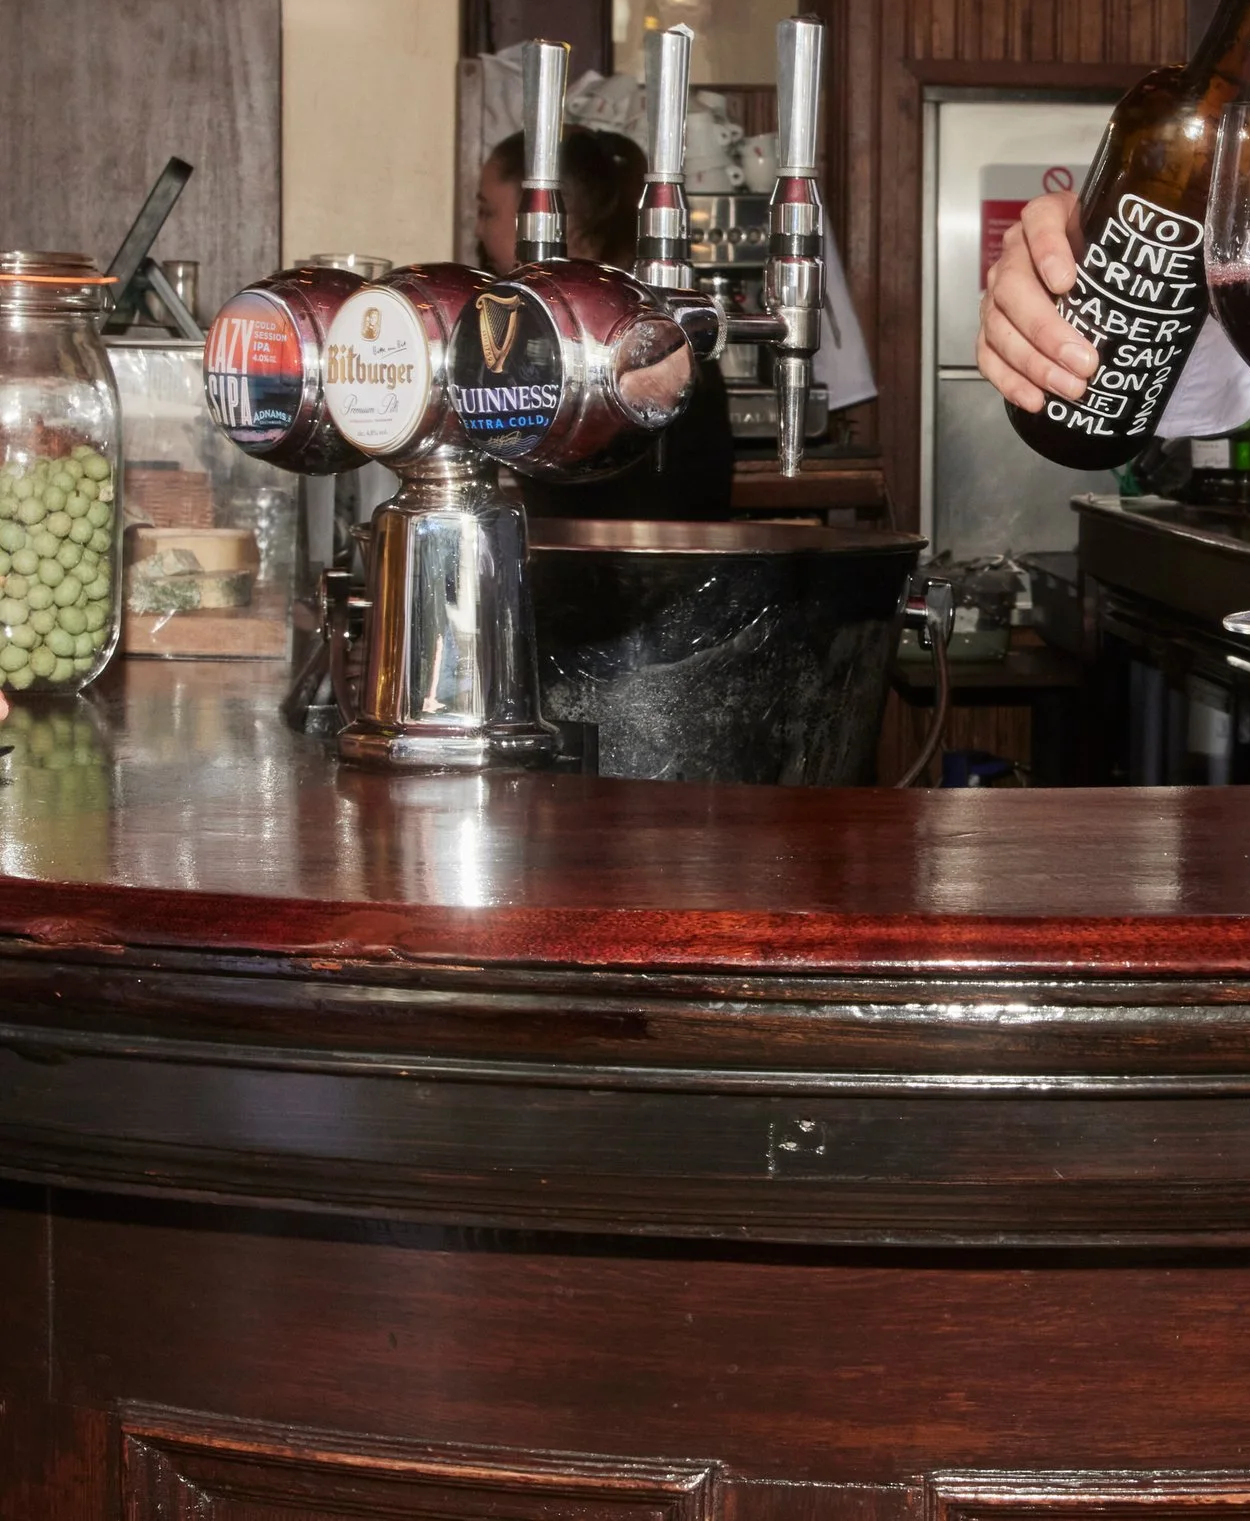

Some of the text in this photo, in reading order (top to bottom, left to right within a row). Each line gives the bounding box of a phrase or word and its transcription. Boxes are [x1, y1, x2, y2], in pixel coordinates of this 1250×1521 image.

[1128, 203, 1180, 242] NO
[1100, 217, 1195, 275] FINE
[1083, 243, 1197, 308] PRINT
[254, 331, 287, 342] SESSION
[255, 321, 276, 331] COLD
[208, 317, 255, 375] LAZY
[253, 341, 270, 353] IPA
[1113, 344, 1182, 368] SAU-
[327, 343, 414, 391] Bitburger
[208, 374, 253, 428] SIPA
[450, 383, 554, 413] GUINNESS
[253, 409, 287, 424] ADNAMS
[465, 414, 544, 430] EXTRA COLD
